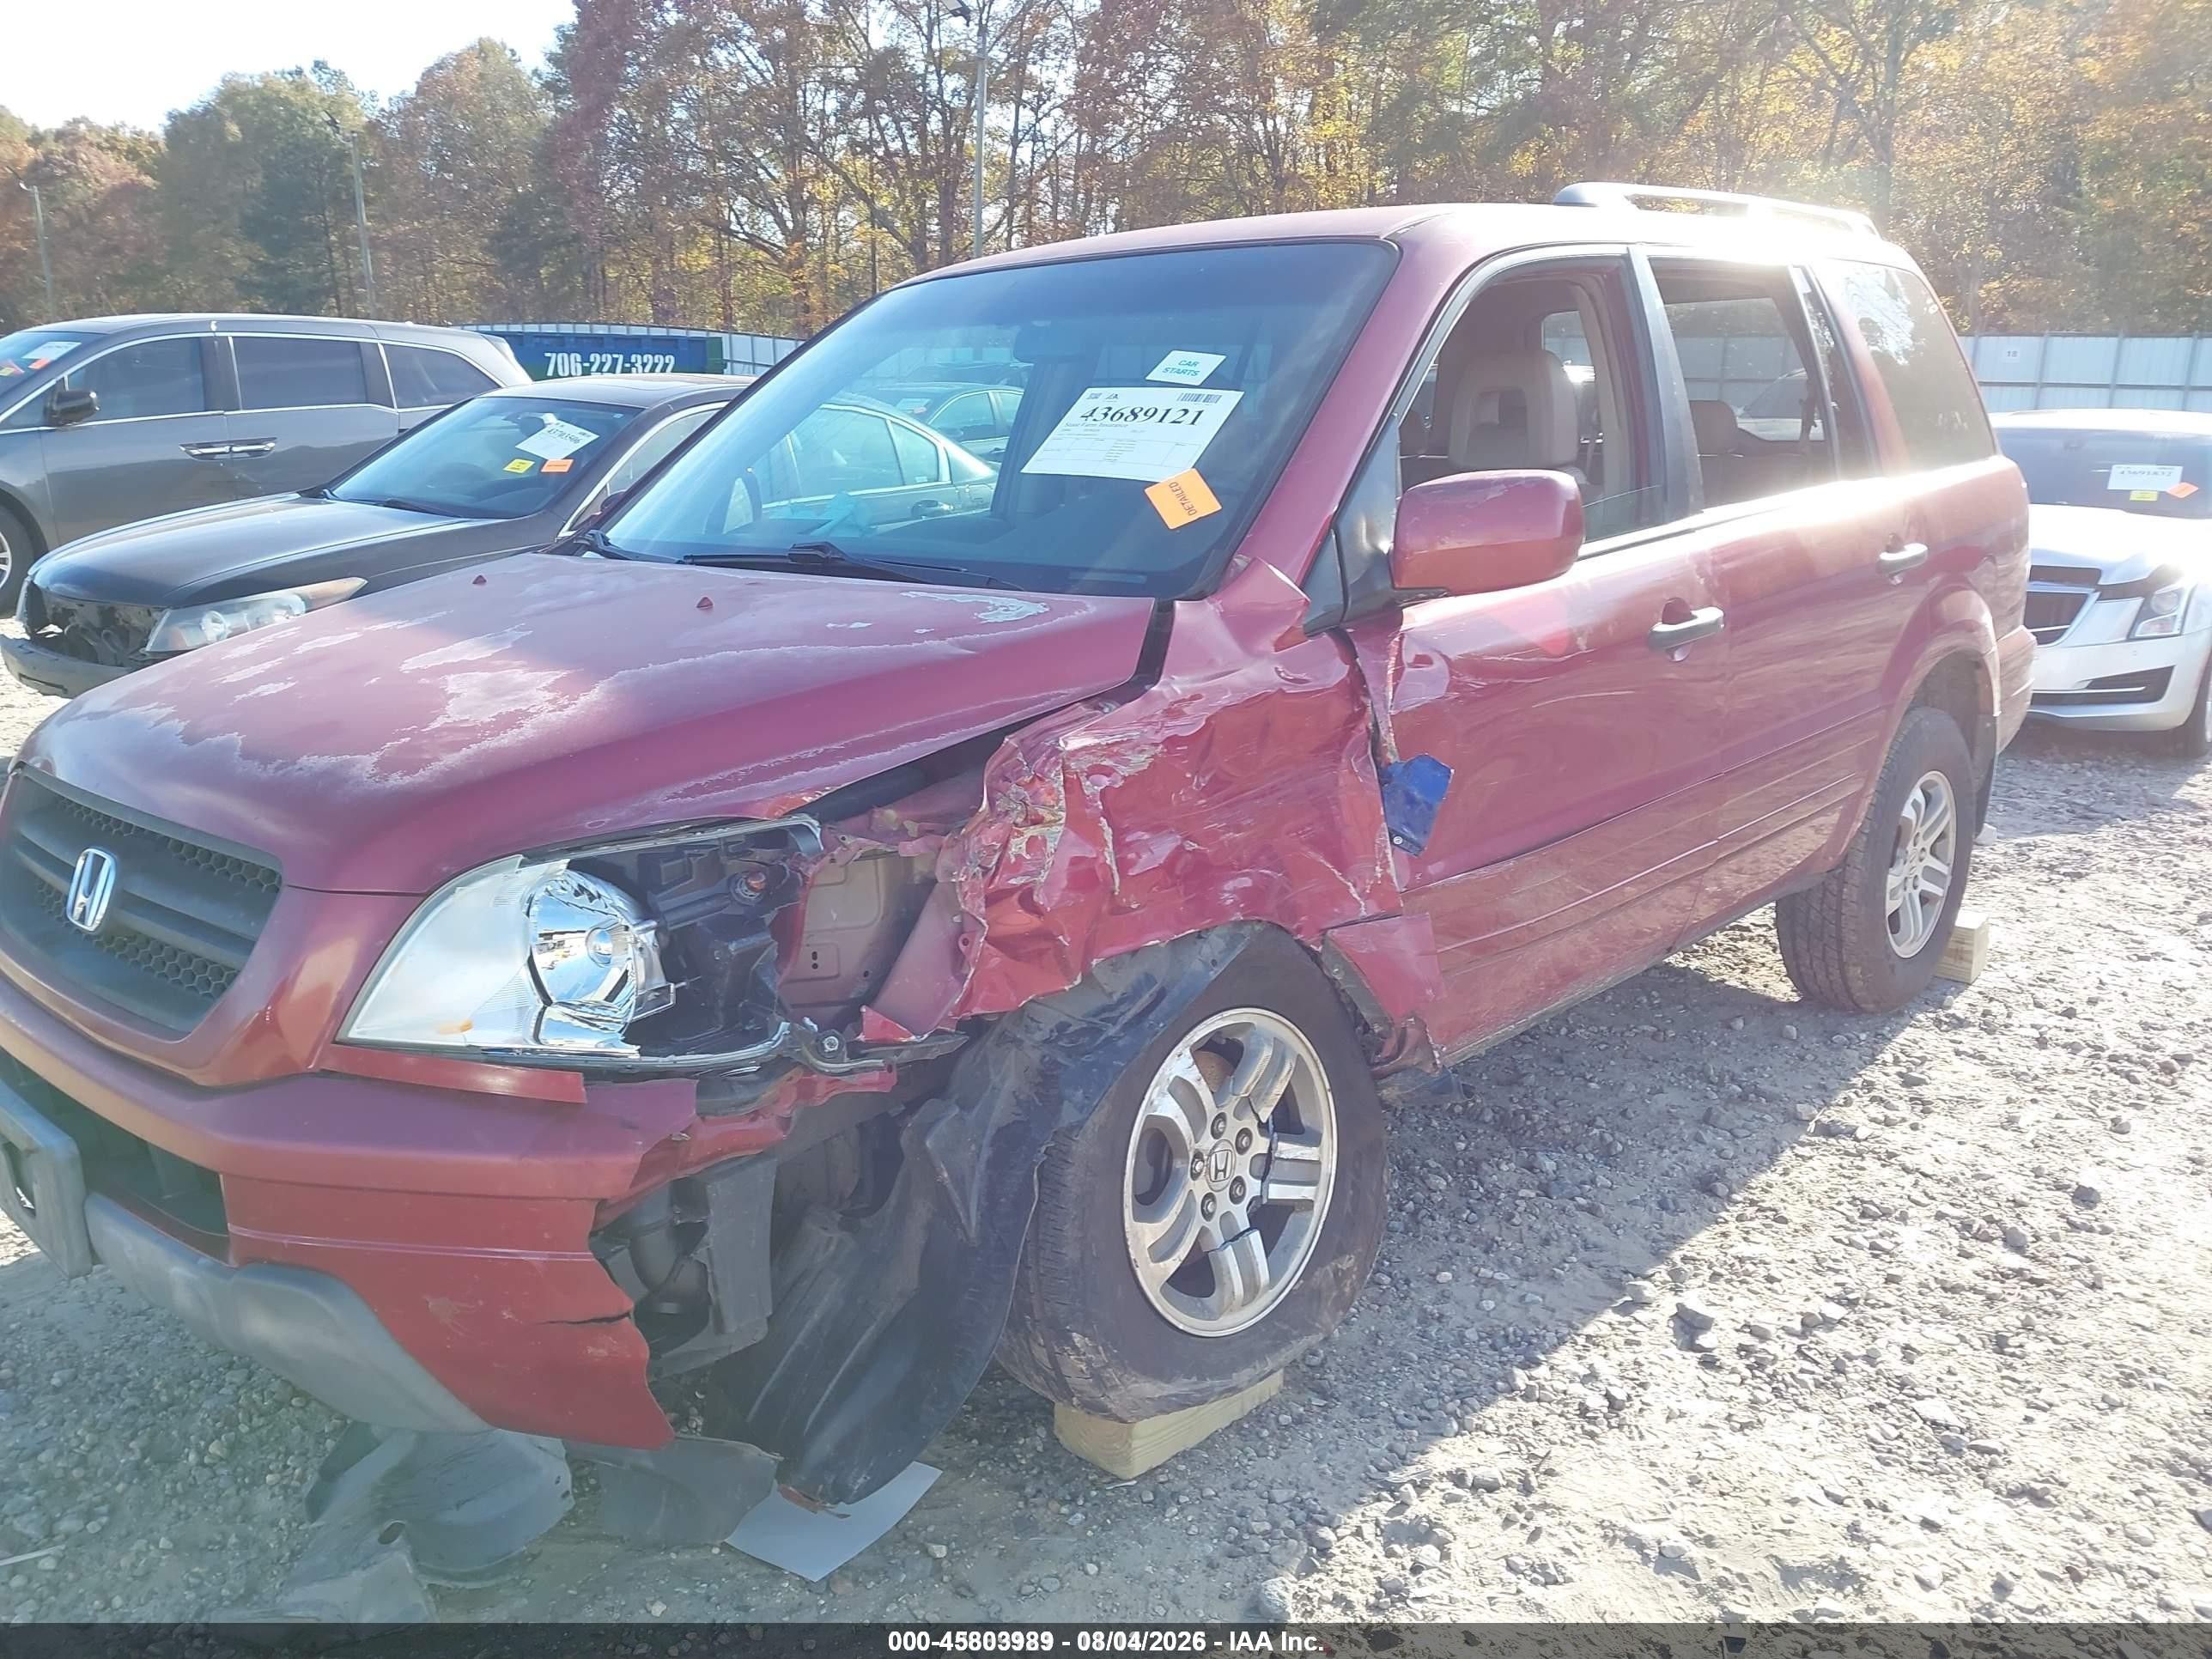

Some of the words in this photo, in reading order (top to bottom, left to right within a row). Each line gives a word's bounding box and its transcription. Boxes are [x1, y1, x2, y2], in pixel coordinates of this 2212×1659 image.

[544, 352, 675, 376] 706-227-3222
[1162, 367, 1200, 376] STARTS
[1080, 405, 1204, 427] 43689121
[1169, 482, 1198, 516] DETAILED
